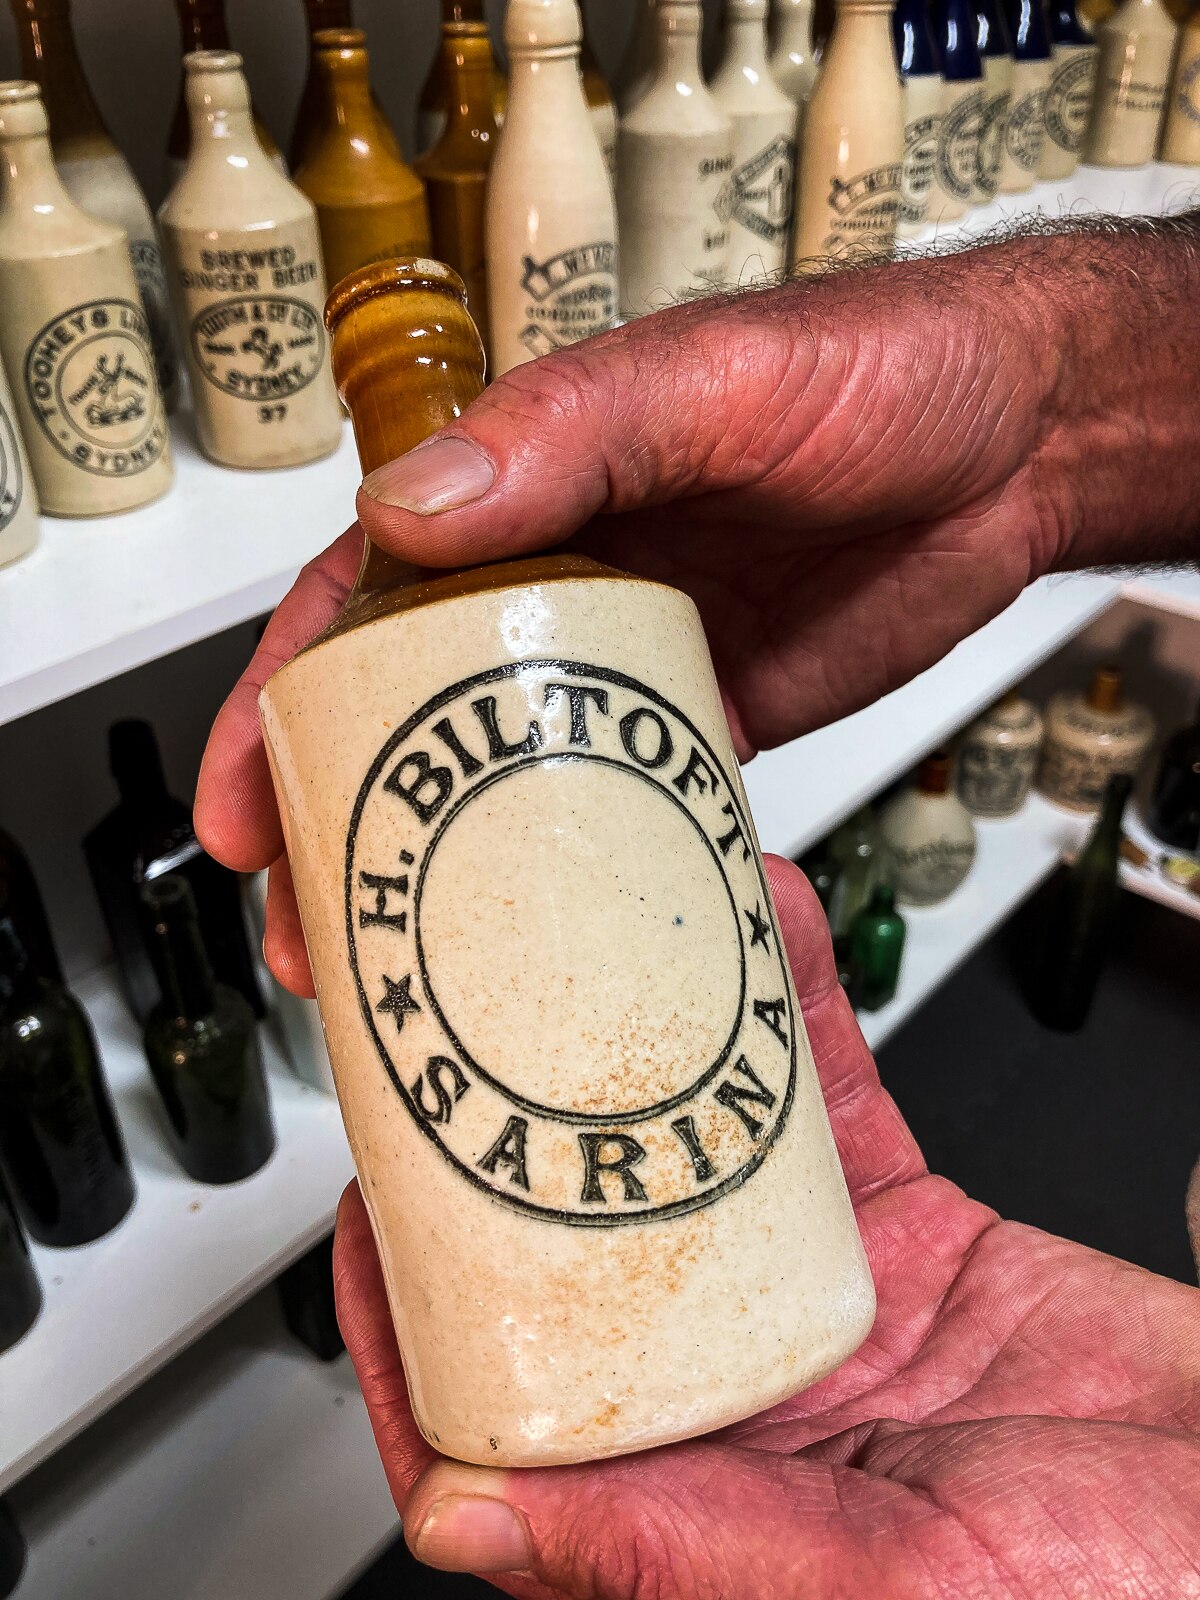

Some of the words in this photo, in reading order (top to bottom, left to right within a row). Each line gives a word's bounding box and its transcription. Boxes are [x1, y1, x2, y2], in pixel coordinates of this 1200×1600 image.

[201, 246, 296, 271] BREWED
[383, 683, 751, 864] BILTOFT
[359, 848, 415, 934] H.
[410, 997, 790, 1204] SARINA
